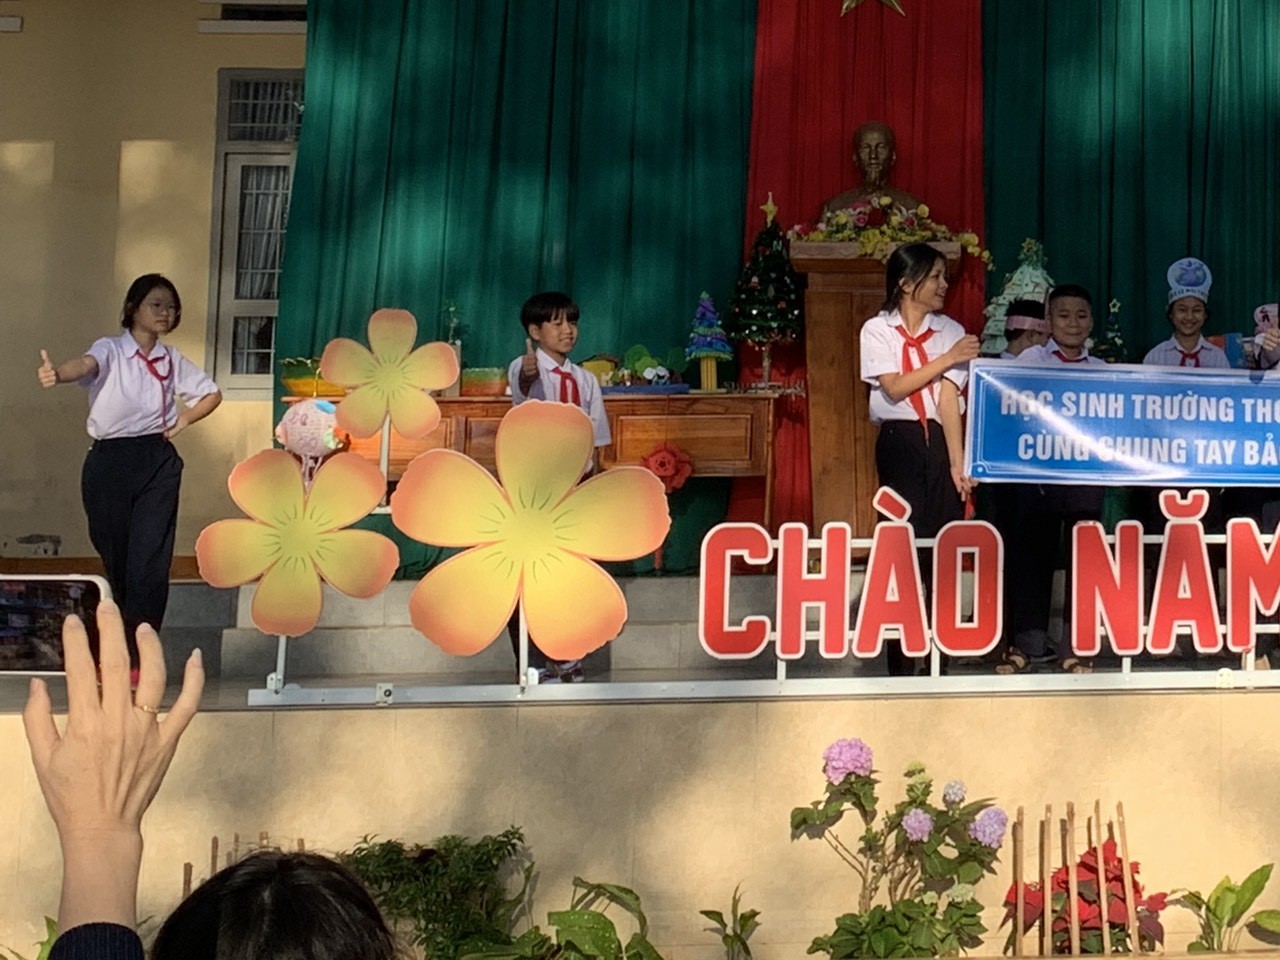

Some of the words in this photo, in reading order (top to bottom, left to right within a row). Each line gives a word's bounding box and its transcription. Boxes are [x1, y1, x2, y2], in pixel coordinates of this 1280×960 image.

[1001, 389, 1053, 422] HỌC
[1061, 391, 1125, 419] SINH
[1131, 390, 1235, 423] TRƯỜNG
[1017, 430, 1090, 462] CÙNG
[1101, 436, 1187, 465] CHUNG
[1193, 439, 1237, 466] TAY
[699, 486, 1004, 661] CHÀO
